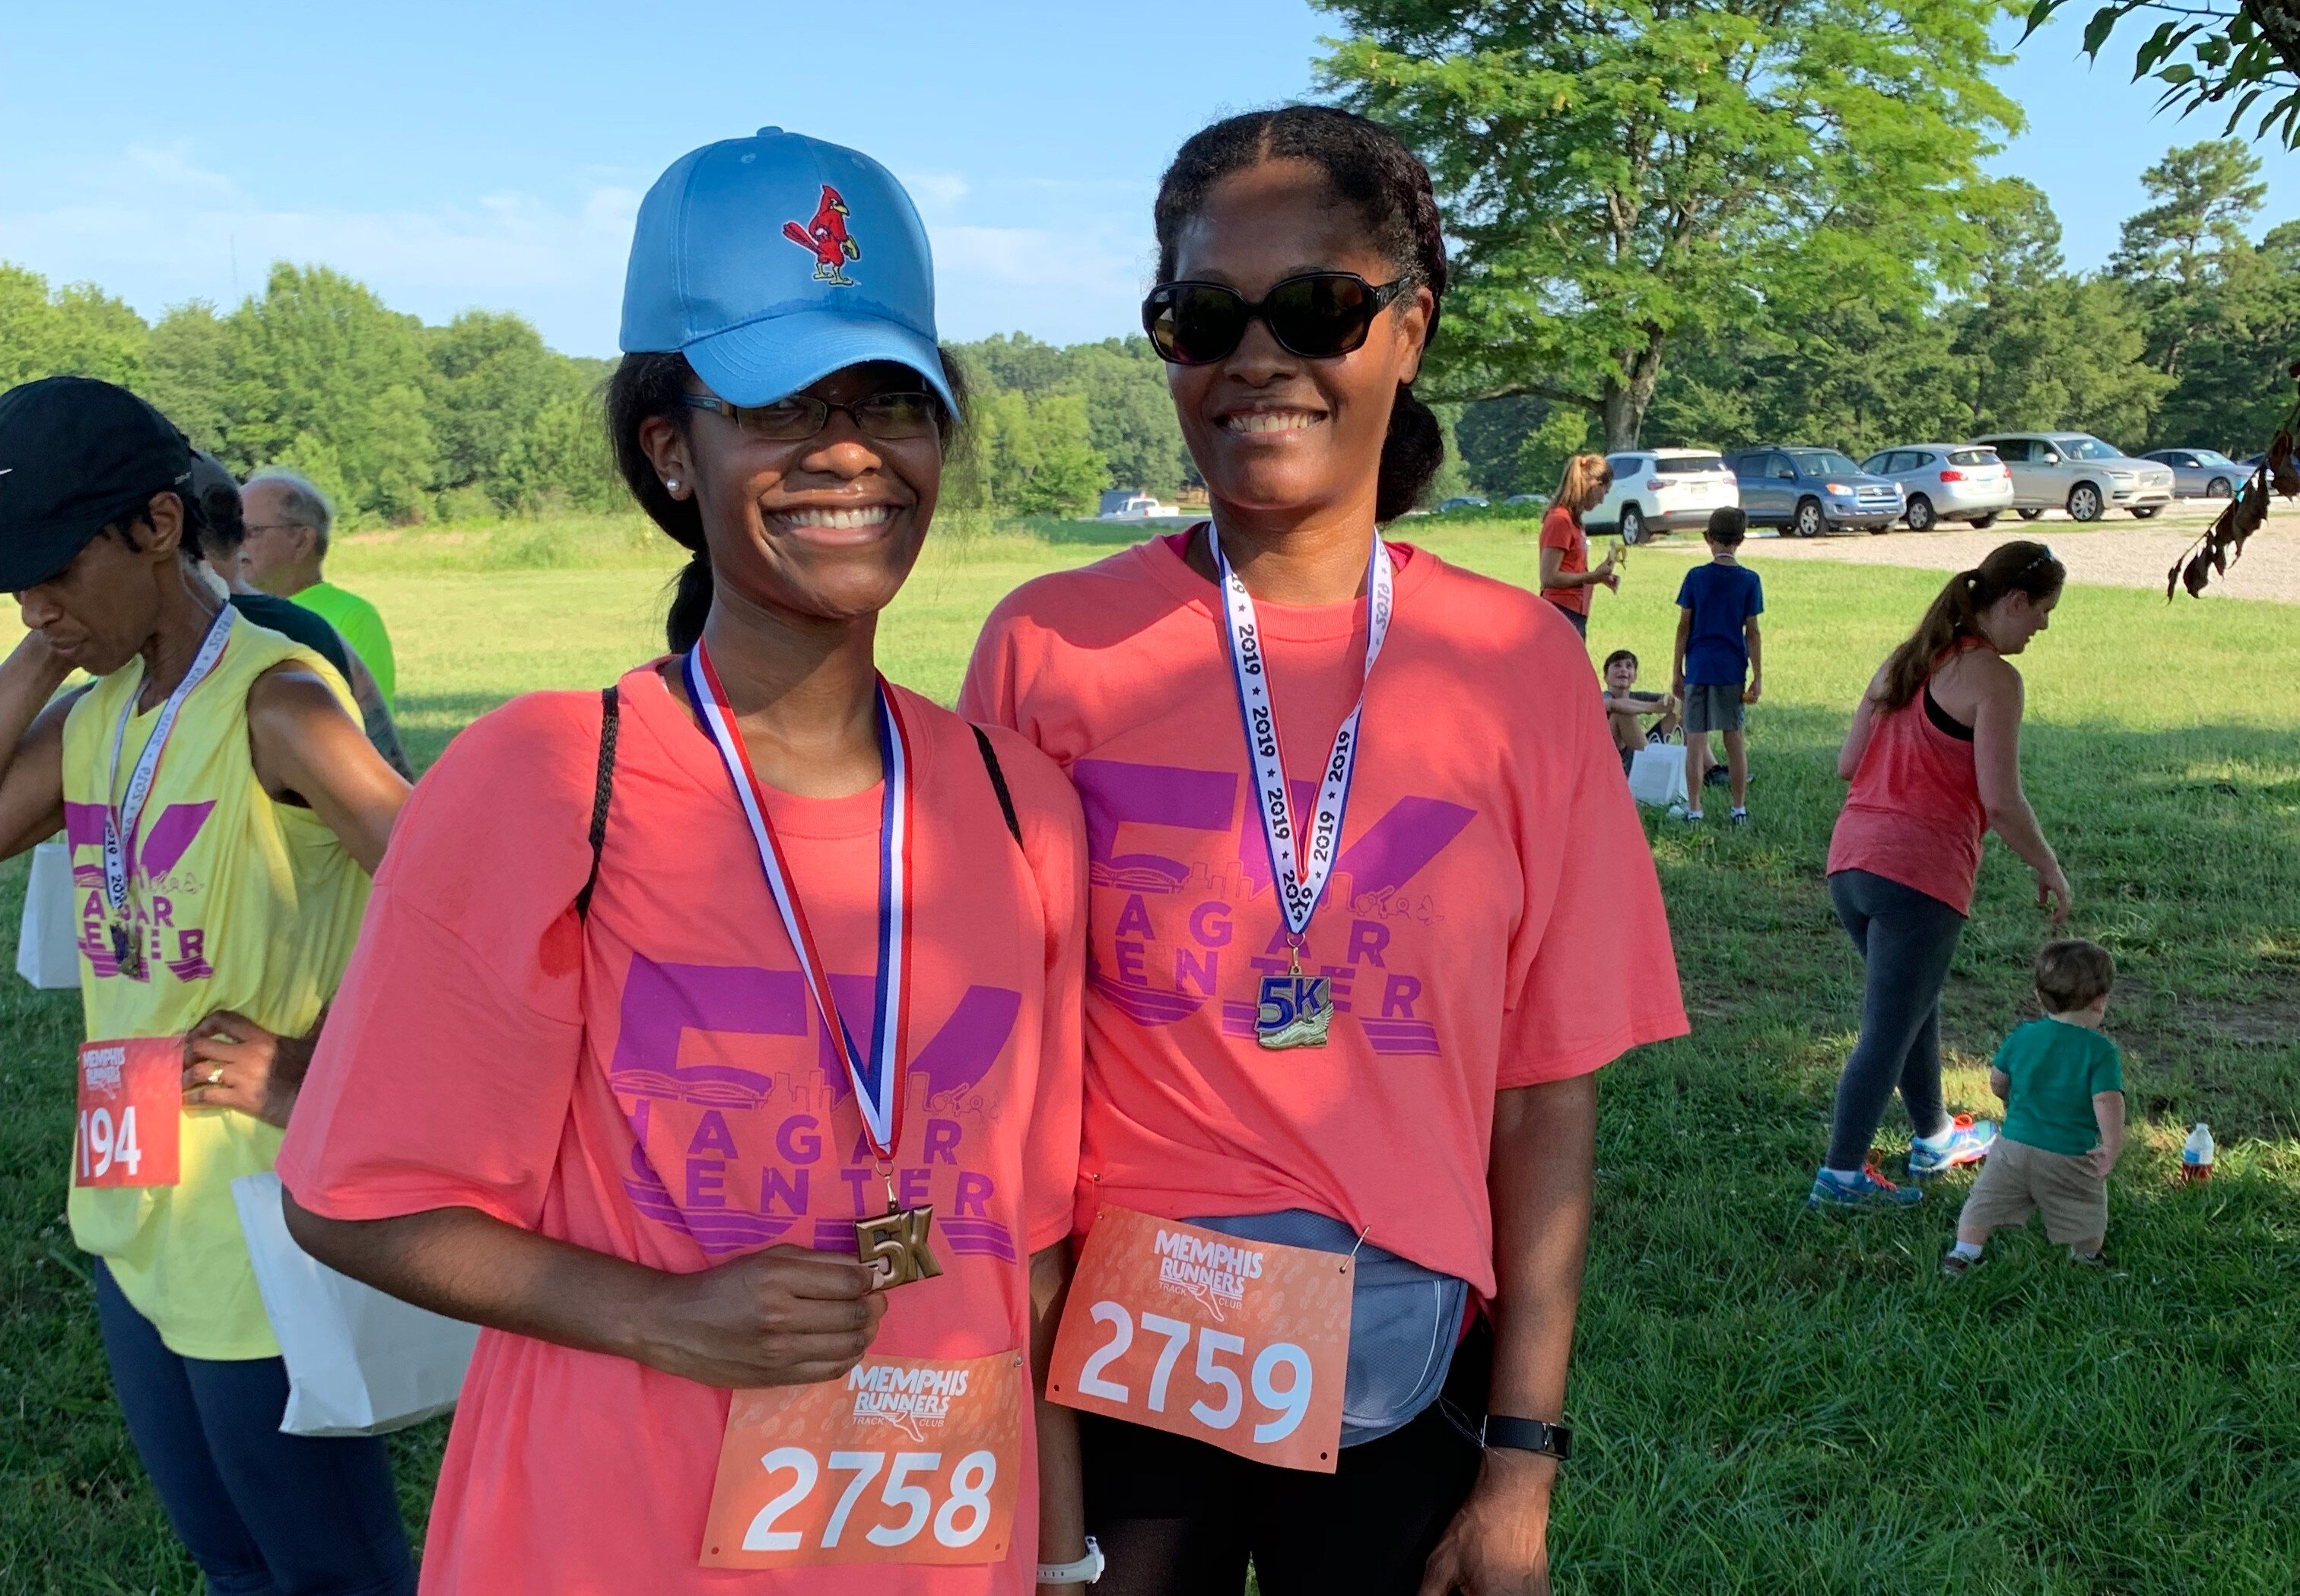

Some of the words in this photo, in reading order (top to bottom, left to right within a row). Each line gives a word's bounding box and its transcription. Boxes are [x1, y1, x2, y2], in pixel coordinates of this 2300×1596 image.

[1238, 623, 1261, 676] 2019
[1252, 706, 1275, 758] 2019
[1267, 787, 1290, 840] 2019
[1313, 811, 1335, 863] 2019
[1328, 731, 1350, 783] 2019
[1115, 893, 1391, 969] AGAR
[1115, 939, 1422, 1019] ENTER
[1255, 976, 1329, 1033] 5K
[80, 1106, 141, 1178] 194
[854, 1204, 944, 1290] 5K
[1154, 1229, 1263, 1279] MEMPHIS
[1160, 1257, 1245, 1295] RUNNERS
[1158, 1281, 1187, 1296] TRACK
[1218, 1297, 1243, 1310] CLUB
[847, 1364, 969, 1396] MEMPHIS
[855, 1391, 950, 1414] RUNNERS
[1078, 1300, 1312, 1443] 2759
[852, 1417, 885, 1426] TRACK
[919, 1418, 945, 1428] CLUB
[742, 1447, 996, 1550] 2758
